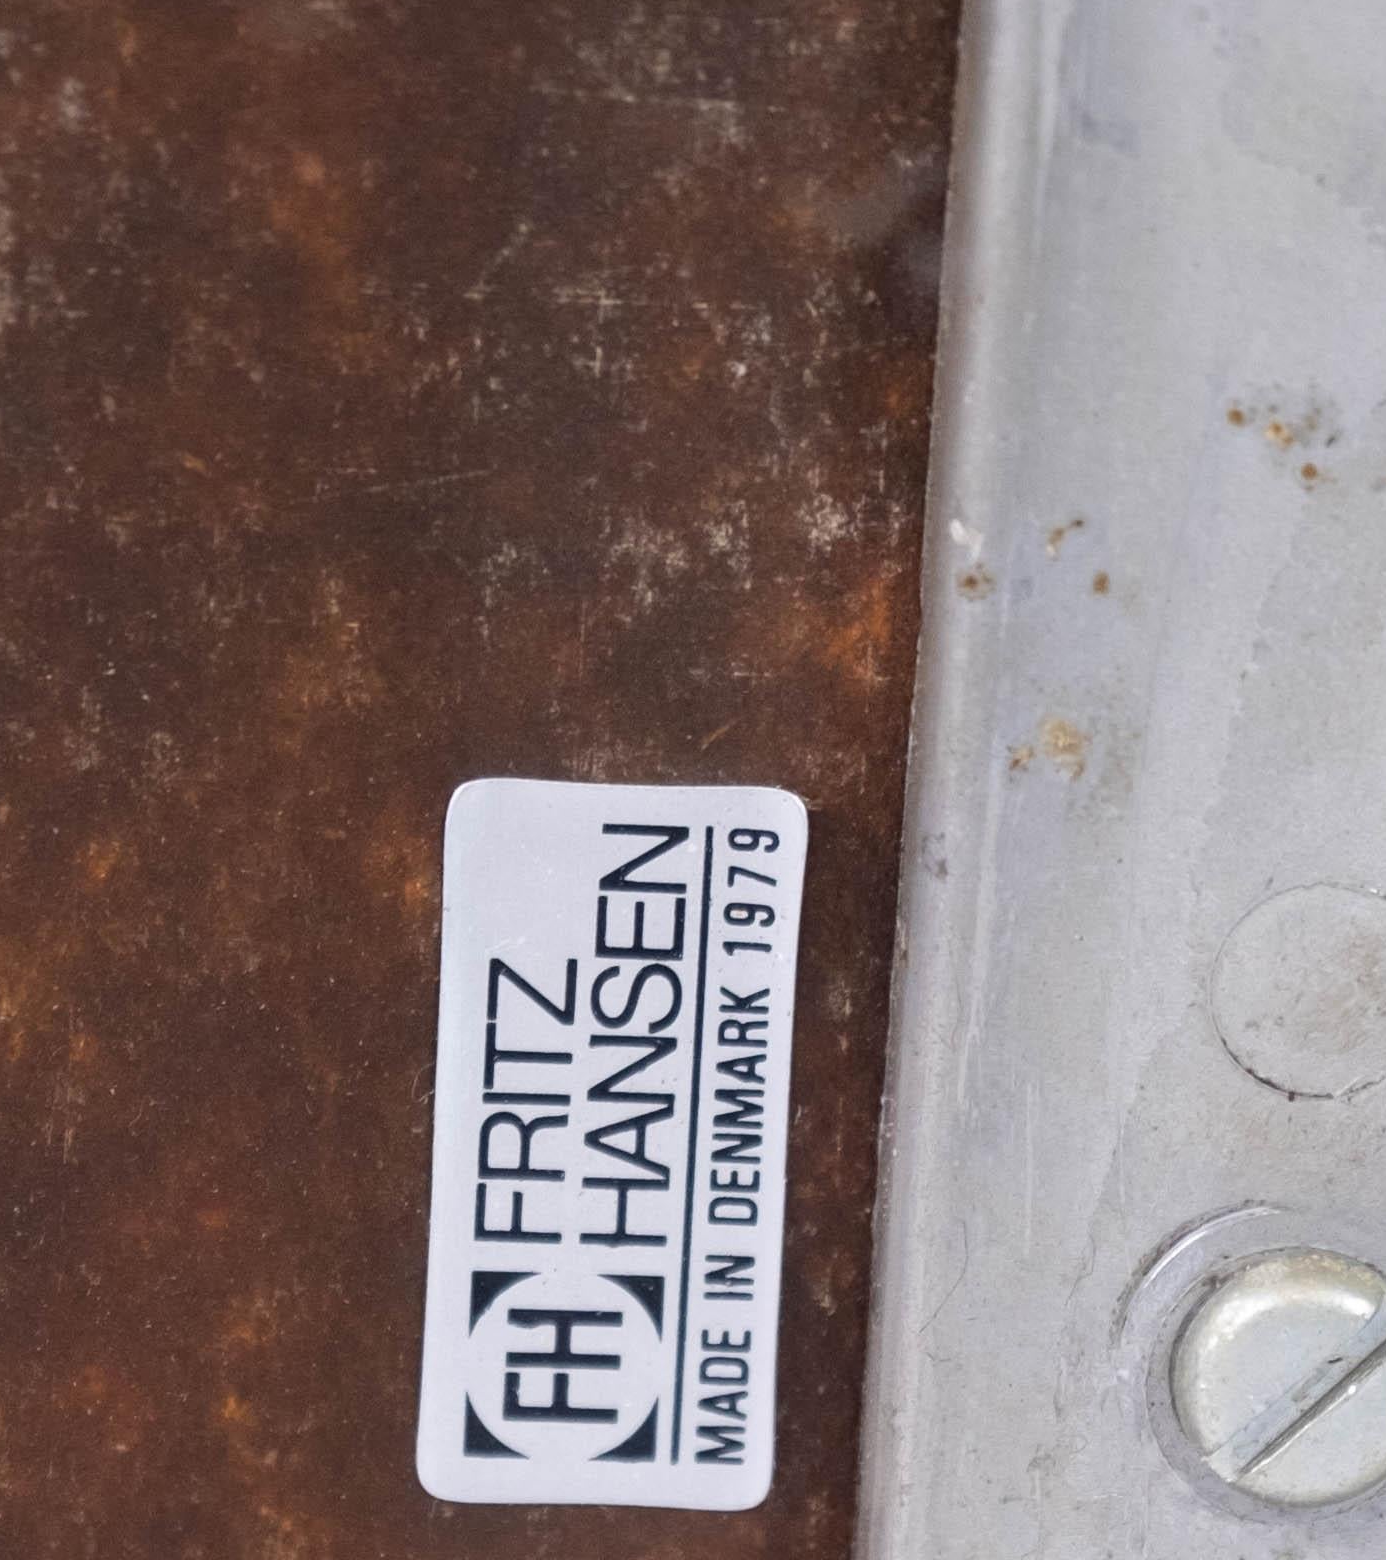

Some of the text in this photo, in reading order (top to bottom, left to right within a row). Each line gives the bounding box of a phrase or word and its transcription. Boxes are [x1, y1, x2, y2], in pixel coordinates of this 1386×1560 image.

[474, 958, 577, 1244] FRITZ
[580, 822, 691, 1247] HANSEN
[695, 828, 780, 1465] MADE IN DENMARK 1979
[503, 1308, 623, 1424] FH
